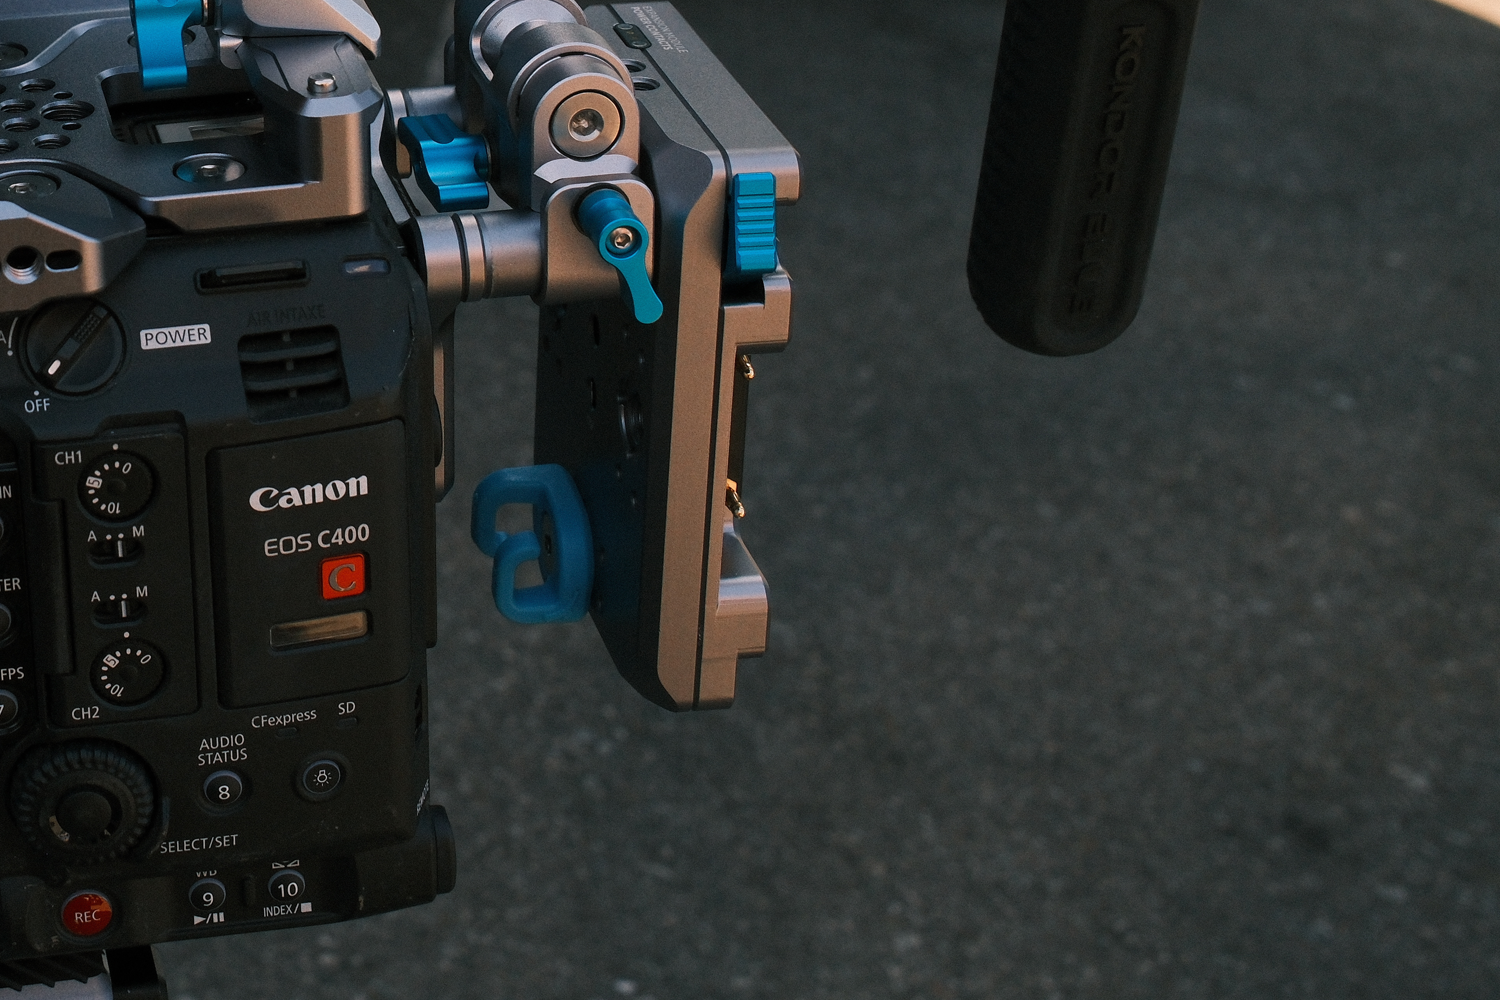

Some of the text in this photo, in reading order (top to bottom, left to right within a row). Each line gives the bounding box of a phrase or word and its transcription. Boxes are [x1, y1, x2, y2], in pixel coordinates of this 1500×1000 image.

[630, 6, 674, 51] POWER CONTACTS
[642, 4, 689, 54] EXPANSION MODULE
[1089, 22, 1148, 199] KONDOR
[144, 327, 208, 346] POWER
[24, 398, 51, 414] OFF
[54, 450, 82, 466] CH1
[122, 462, 132, 474] 0
[248, 474, 370, 512] Canon
[107, 502, 120, 514] 10
[87, 524, 145, 542] A M
[264, 523, 370, 558] EOS C400
[328, 564, 356, 592] C
[90, 586, 148, 602] A M
[140, 654, 152, 664] 0
[0, 666, 25, 682] FPS
[110, 684, 124, 698] 10
[71, 706, 100, 720] CH2
[338, 700, 356, 716] SD
[251, 708, 318, 730] CFexpress
[200, 734, 246, 752] AUDIO
[198, 748, 248, 766] STATUS
[218, 784, 231, 800] 8
[160, 834, 239, 854] SELECT/SET
[278, 882, 298, 898] 10
[202, 892, 214, 907] 9
[74, 909, 101, 924] REC
